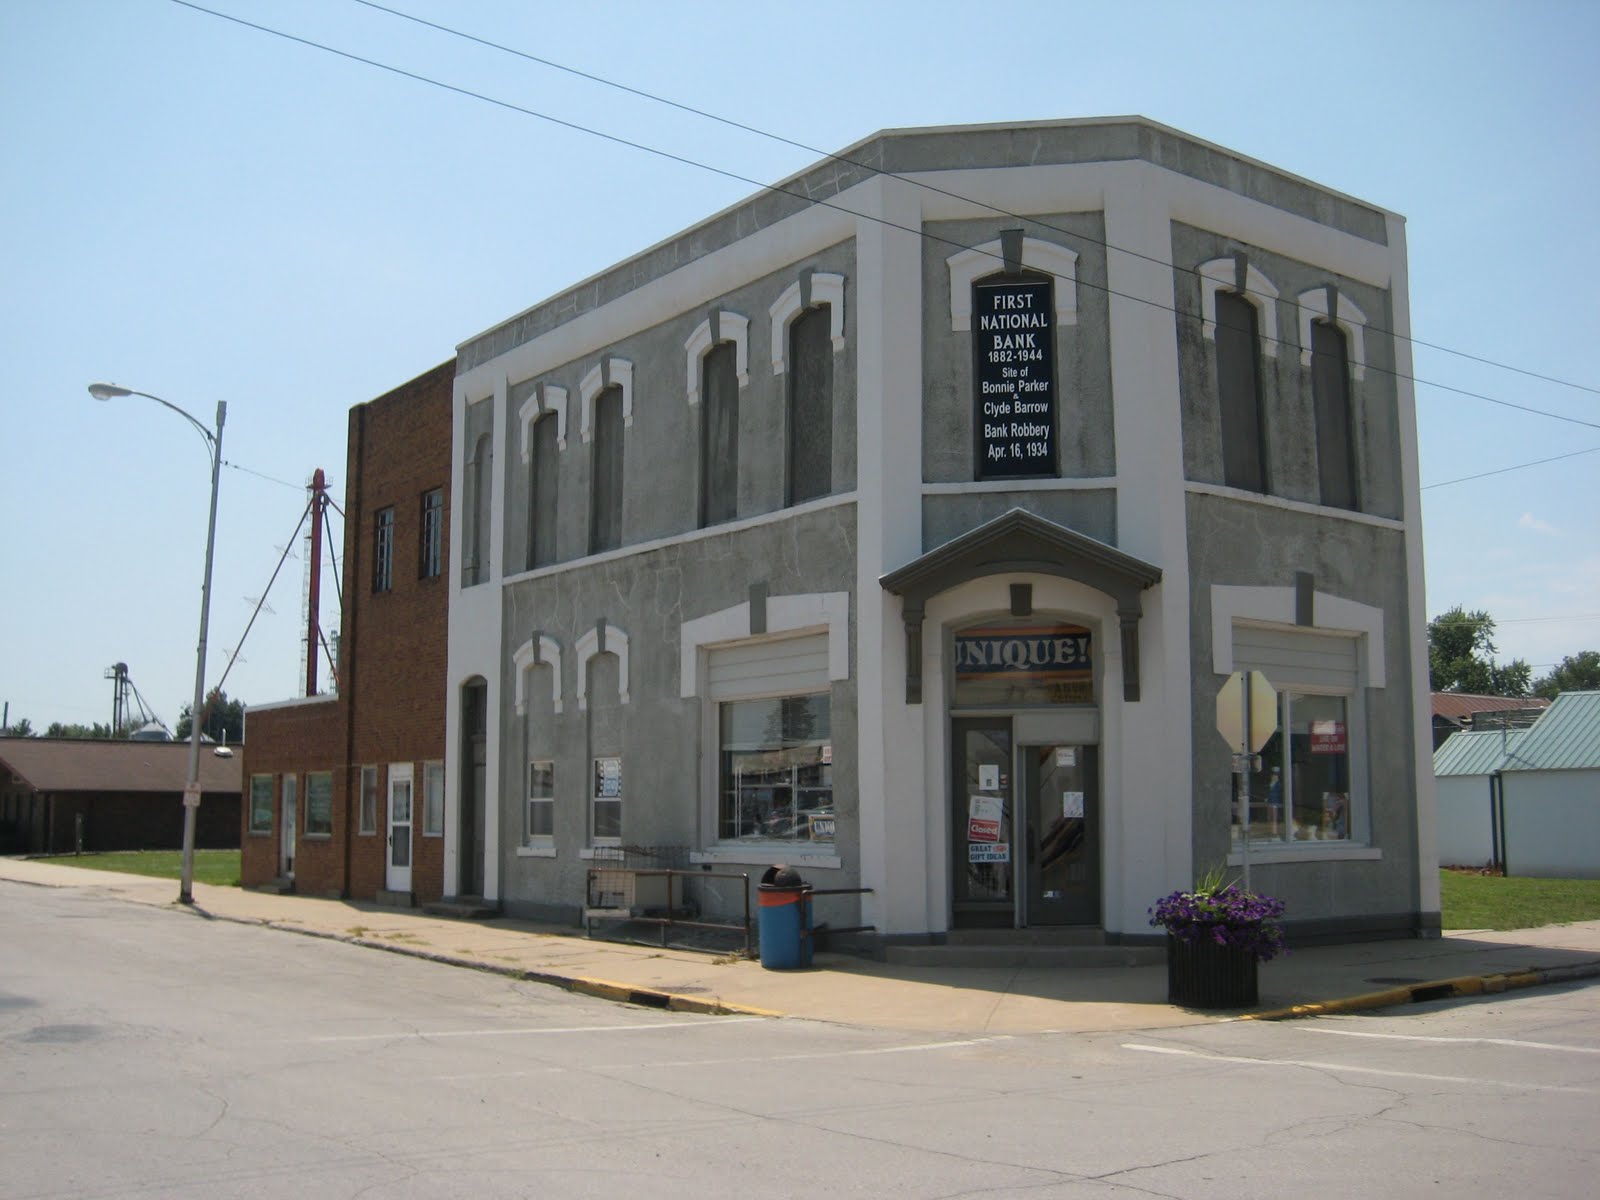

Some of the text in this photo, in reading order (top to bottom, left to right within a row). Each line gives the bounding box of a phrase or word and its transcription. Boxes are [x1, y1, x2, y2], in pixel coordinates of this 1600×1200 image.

[994, 294, 1033, 309] FIRST
[981, 313, 1048, 330] NATIONAL
[993, 334, 1036, 350] BANK
[988, 349, 1042, 362] 1882-1944
[1002, 366, 1028, 378] Site of
[982, 380, 1049, 393] Bonnie Parker
[984, 401, 1049, 417] Clyde Barrow
[984, 422, 1049, 439] Bank Robbery
[988, 442, 1047, 461] Apr. 16, 1934
[970, 824, 998, 835] Closed
